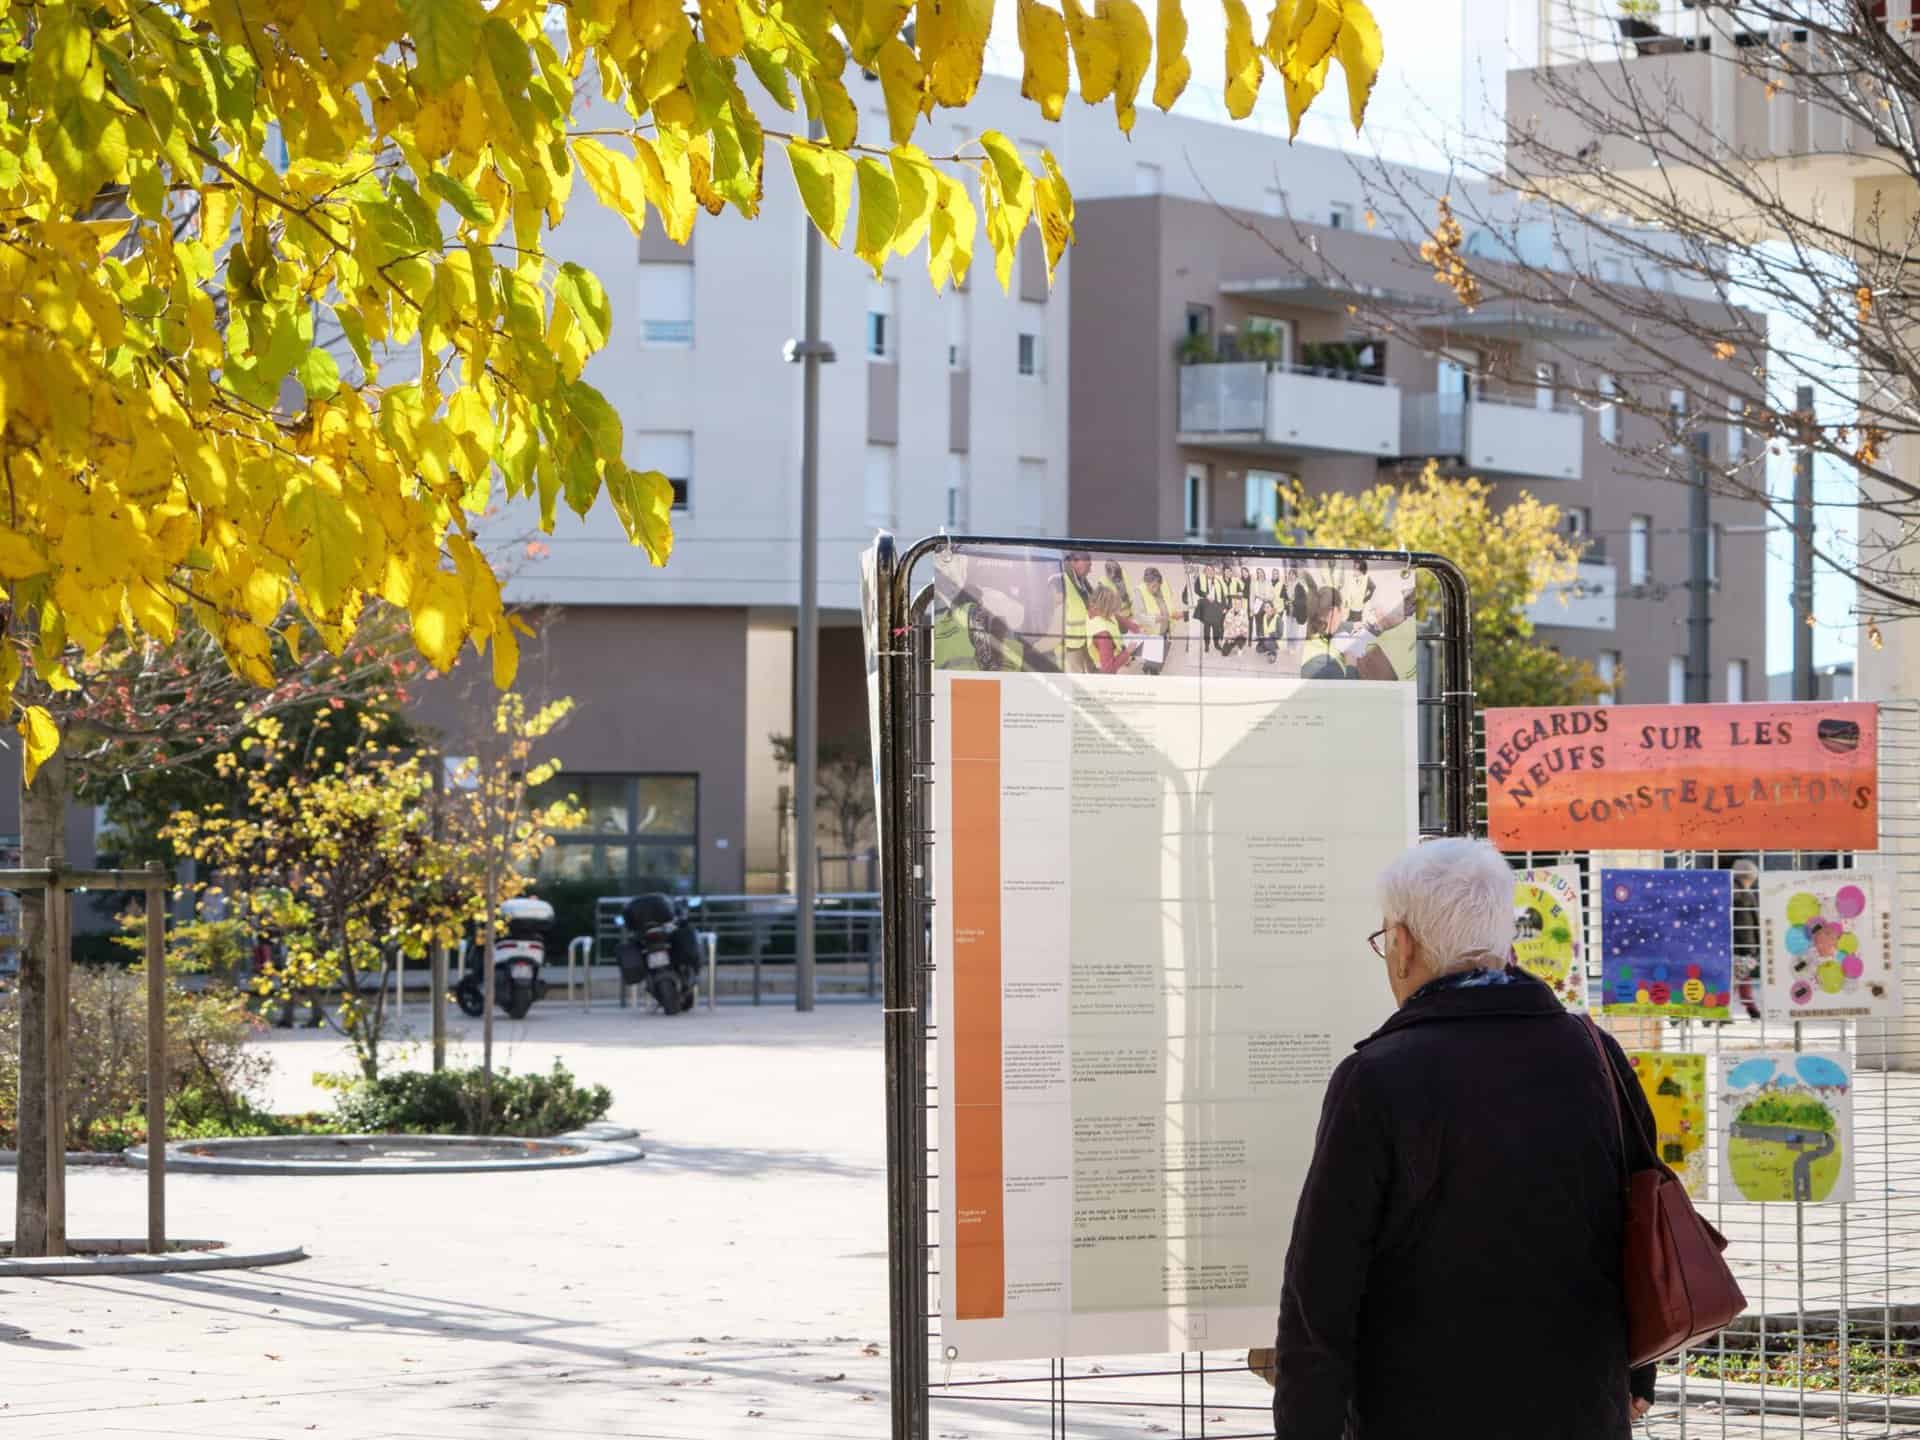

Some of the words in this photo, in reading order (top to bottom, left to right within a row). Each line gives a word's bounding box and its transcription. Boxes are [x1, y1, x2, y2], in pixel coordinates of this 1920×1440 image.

[1488, 709, 1608, 785] REGARDS
[1640, 725, 1702, 750] SUR
[1729, 721, 1793, 746] LES
[1508, 745, 1606, 809] NEUFS
[1568, 777, 1871, 823] CONSTELLATIONS
